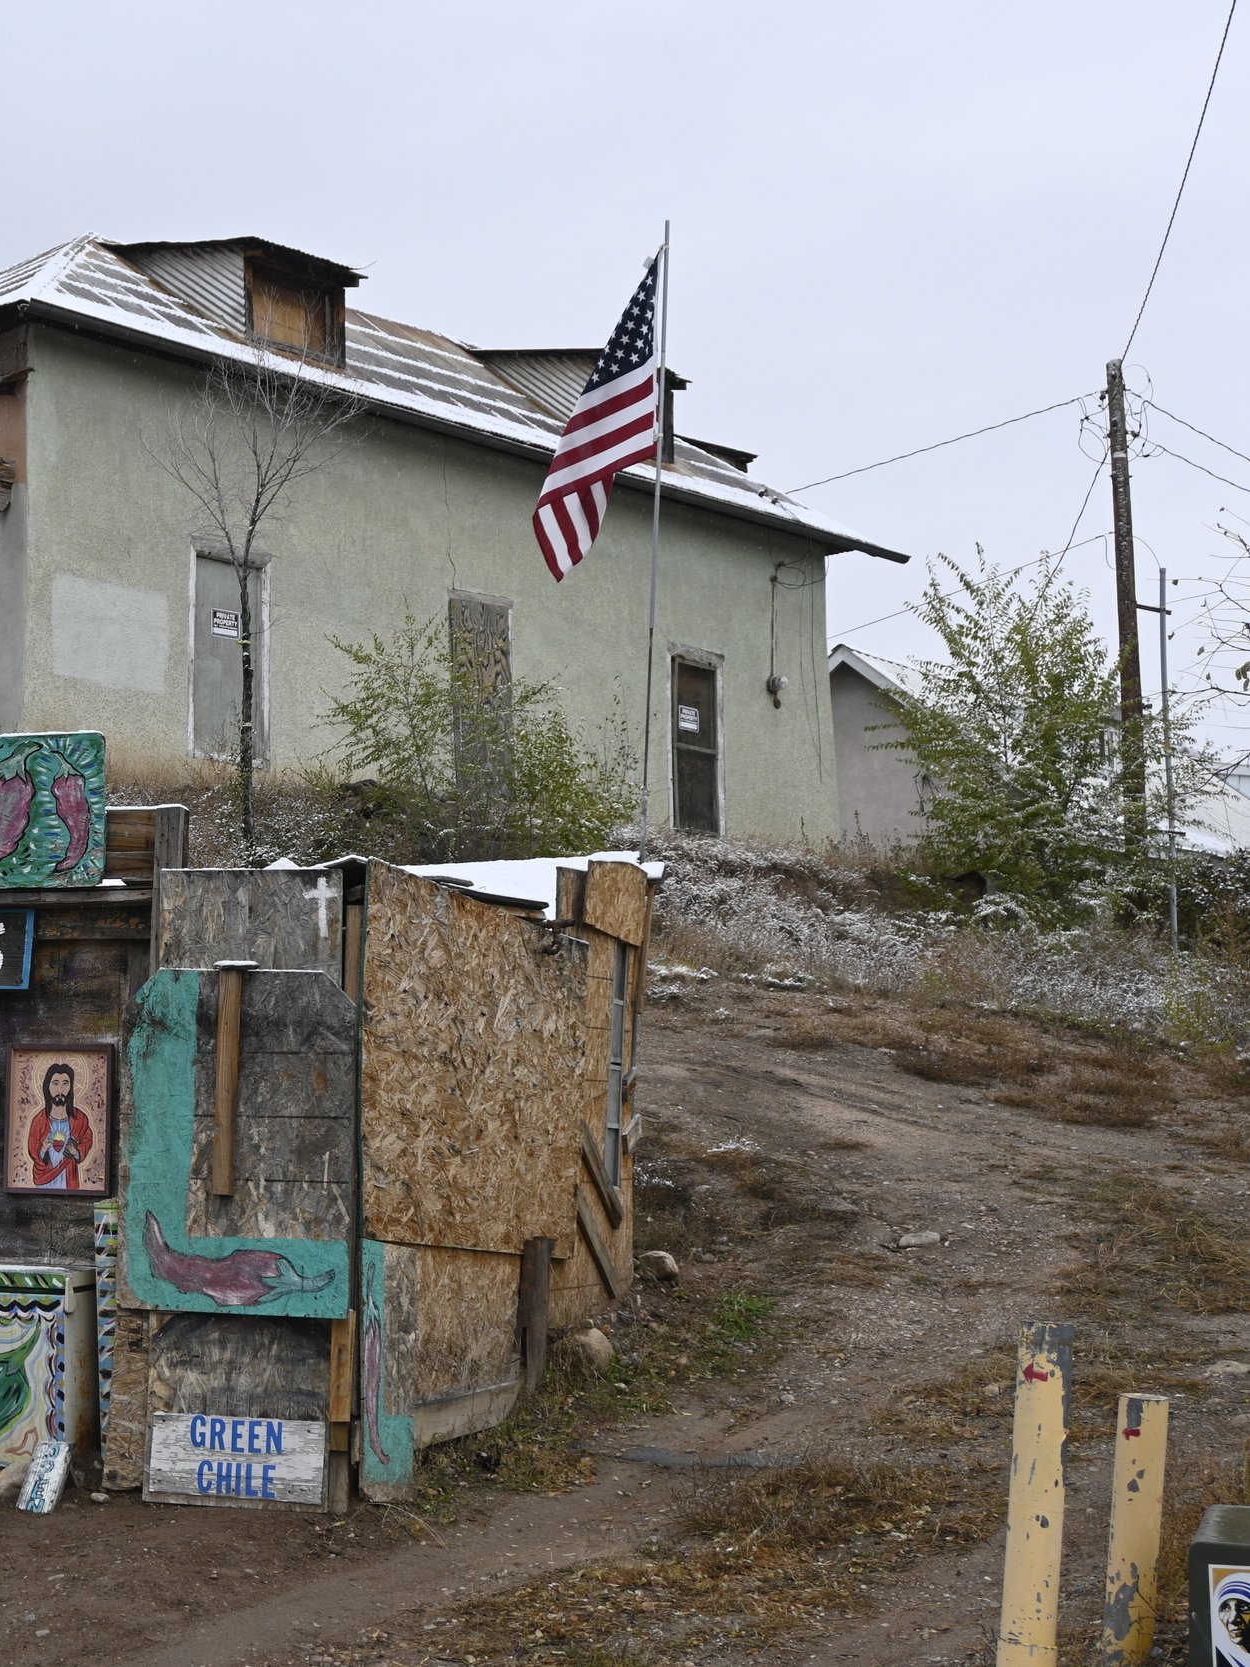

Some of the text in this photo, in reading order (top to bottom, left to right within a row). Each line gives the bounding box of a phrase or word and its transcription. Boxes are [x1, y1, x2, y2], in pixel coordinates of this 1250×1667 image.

[214, 618, 238, 627] PROPERTY
[216, 612, 235, 620] PRIVATE
[190, 1414, 284, 1455] GREEN
[196, 1460, 278, 1499] CHILE
